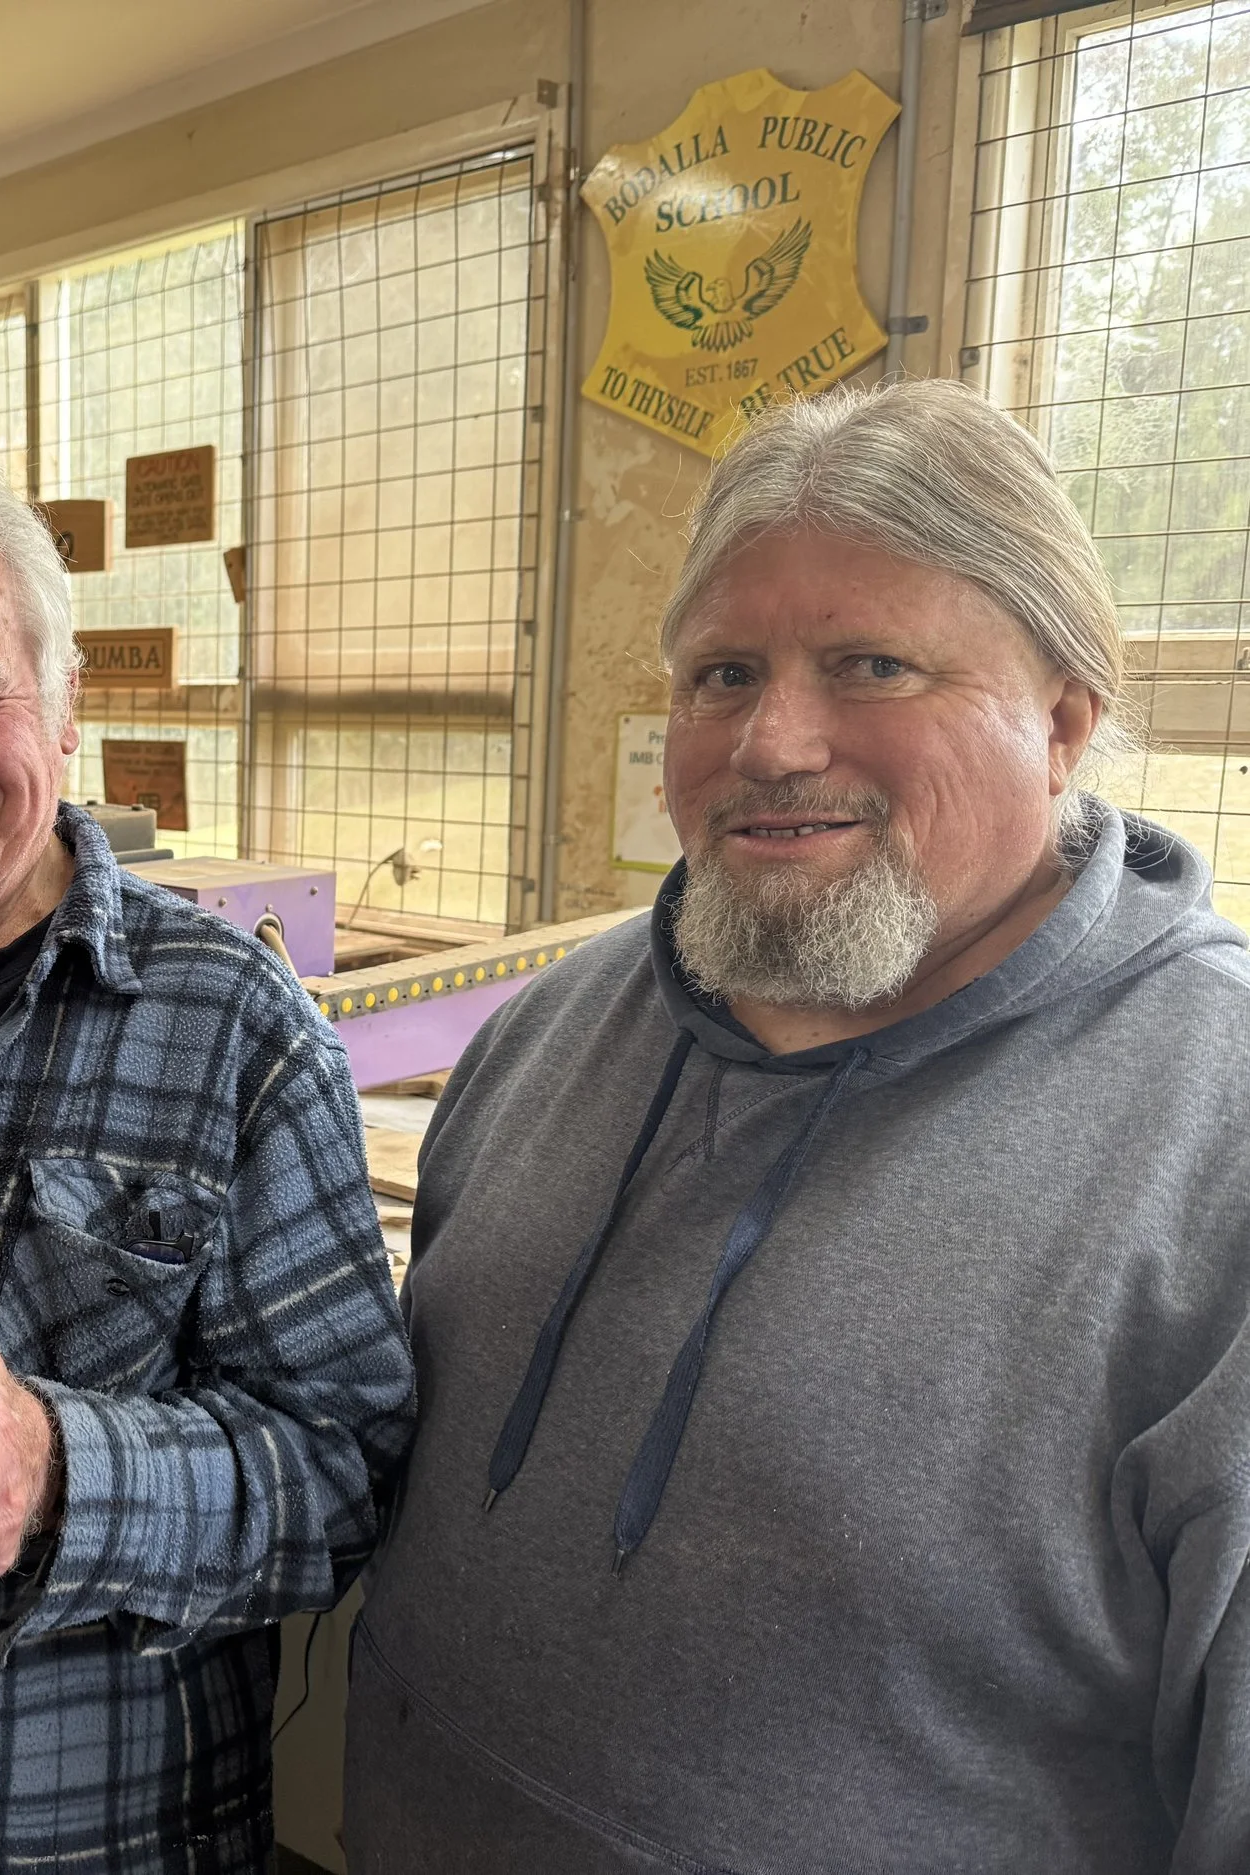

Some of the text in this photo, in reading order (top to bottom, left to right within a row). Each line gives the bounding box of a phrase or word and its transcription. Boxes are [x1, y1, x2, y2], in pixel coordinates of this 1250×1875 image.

[603, 115, 867, 227] BODALLA PUBLIC
[655, 170, 801, 233] SCHOOL
[776, 326, 856, 395] TRUE
[600, 365, 716, 440] TO THYSELF
[91, 644, 162, 669] UMBA
